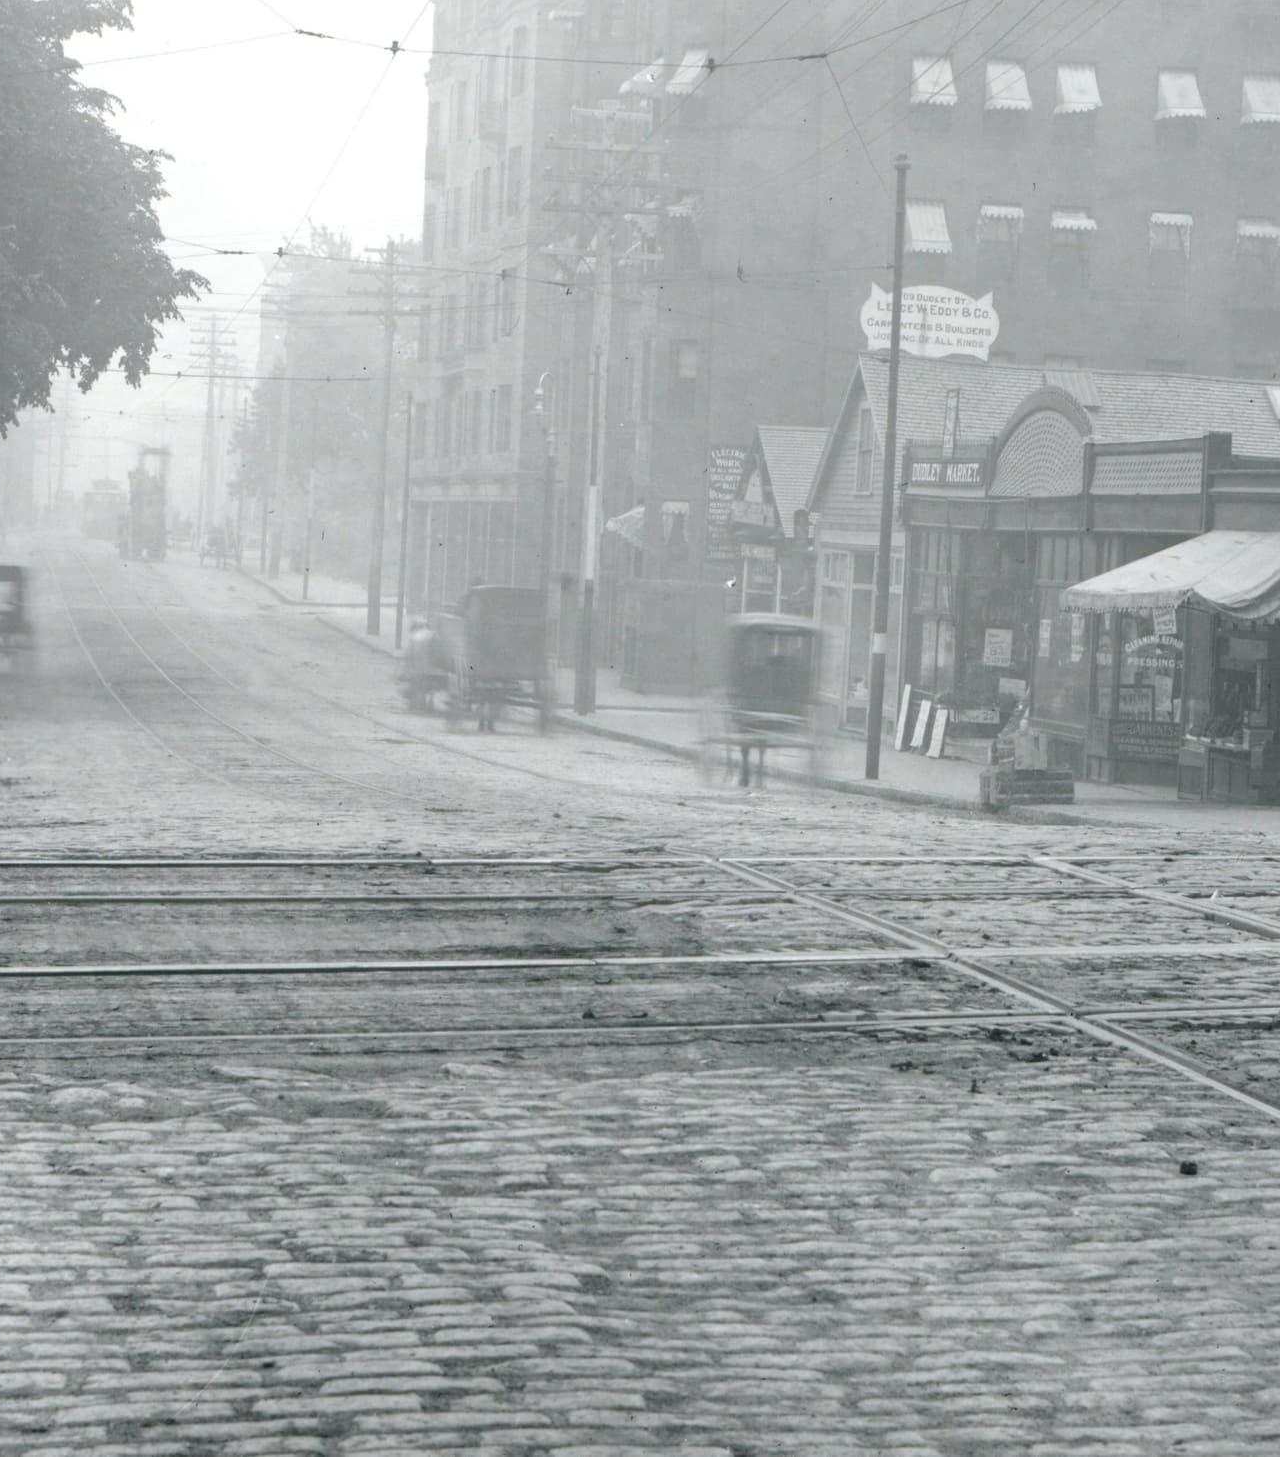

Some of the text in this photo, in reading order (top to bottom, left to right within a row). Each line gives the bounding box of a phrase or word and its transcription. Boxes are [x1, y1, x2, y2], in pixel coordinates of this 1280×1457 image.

[916, 293, 953, 304] DUDLEY
[930, 305, 960, 316] EDDY
[961, 308, 972, 317] &
[866, 318, 934, 331] CARPNTERS
[945, 324, 992, 336] BUILDERS
[934, 336, 953, 346] ALL
[956, 339, 985, 348] KINDS
[912, 463, 942, 482] DUDLEY
[1124, 634, 1160, 653] CLEANING
[1127, 656, 1176, 668] PRESSING
